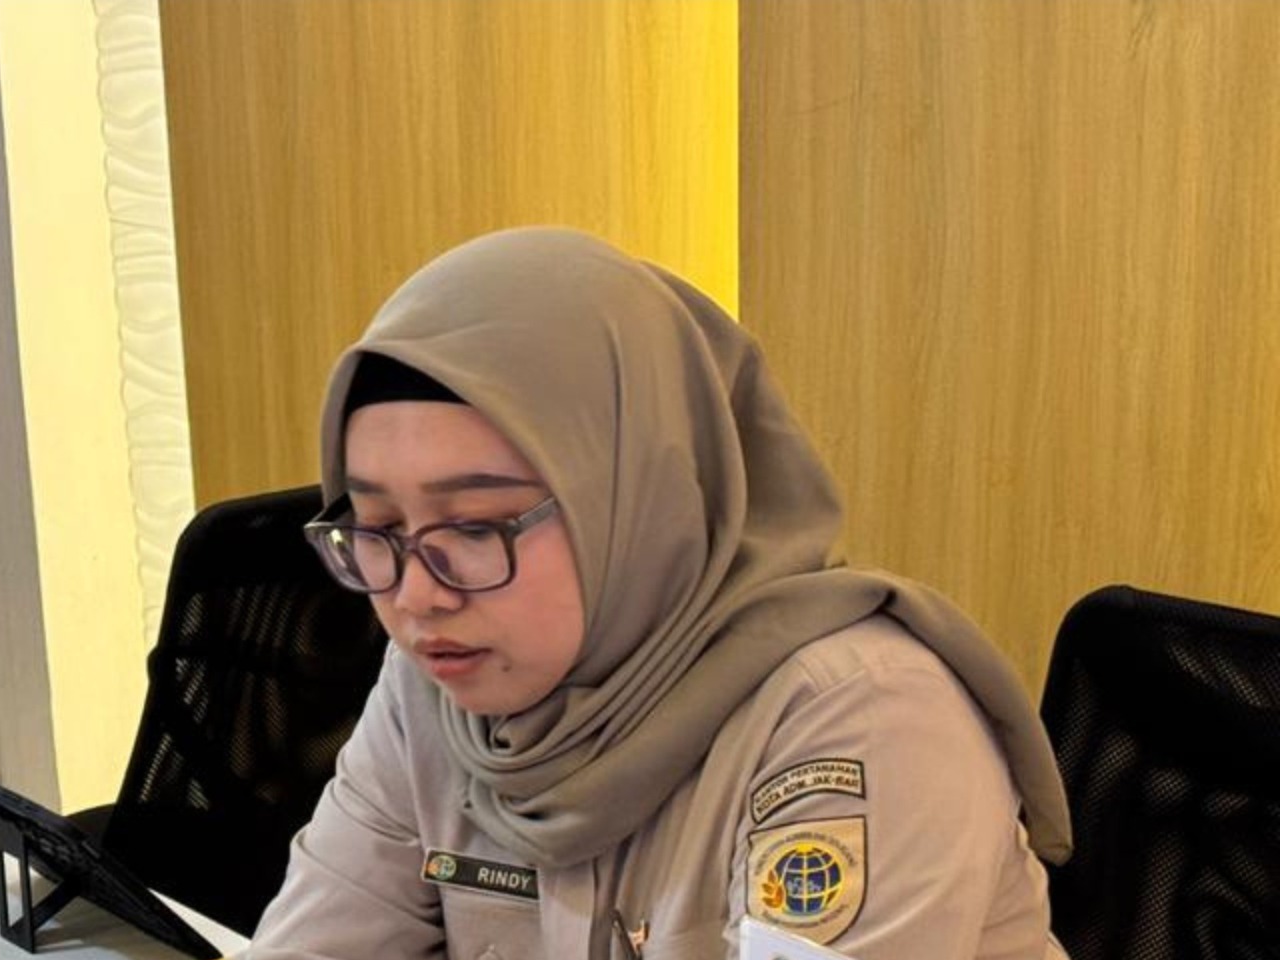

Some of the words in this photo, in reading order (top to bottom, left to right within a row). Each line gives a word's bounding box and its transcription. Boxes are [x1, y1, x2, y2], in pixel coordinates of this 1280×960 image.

[789, 764, 858, 778] PERTANAHAN
[756, 790, 781, 814] KOTA
[477, 866, 532, 891] RINDY
